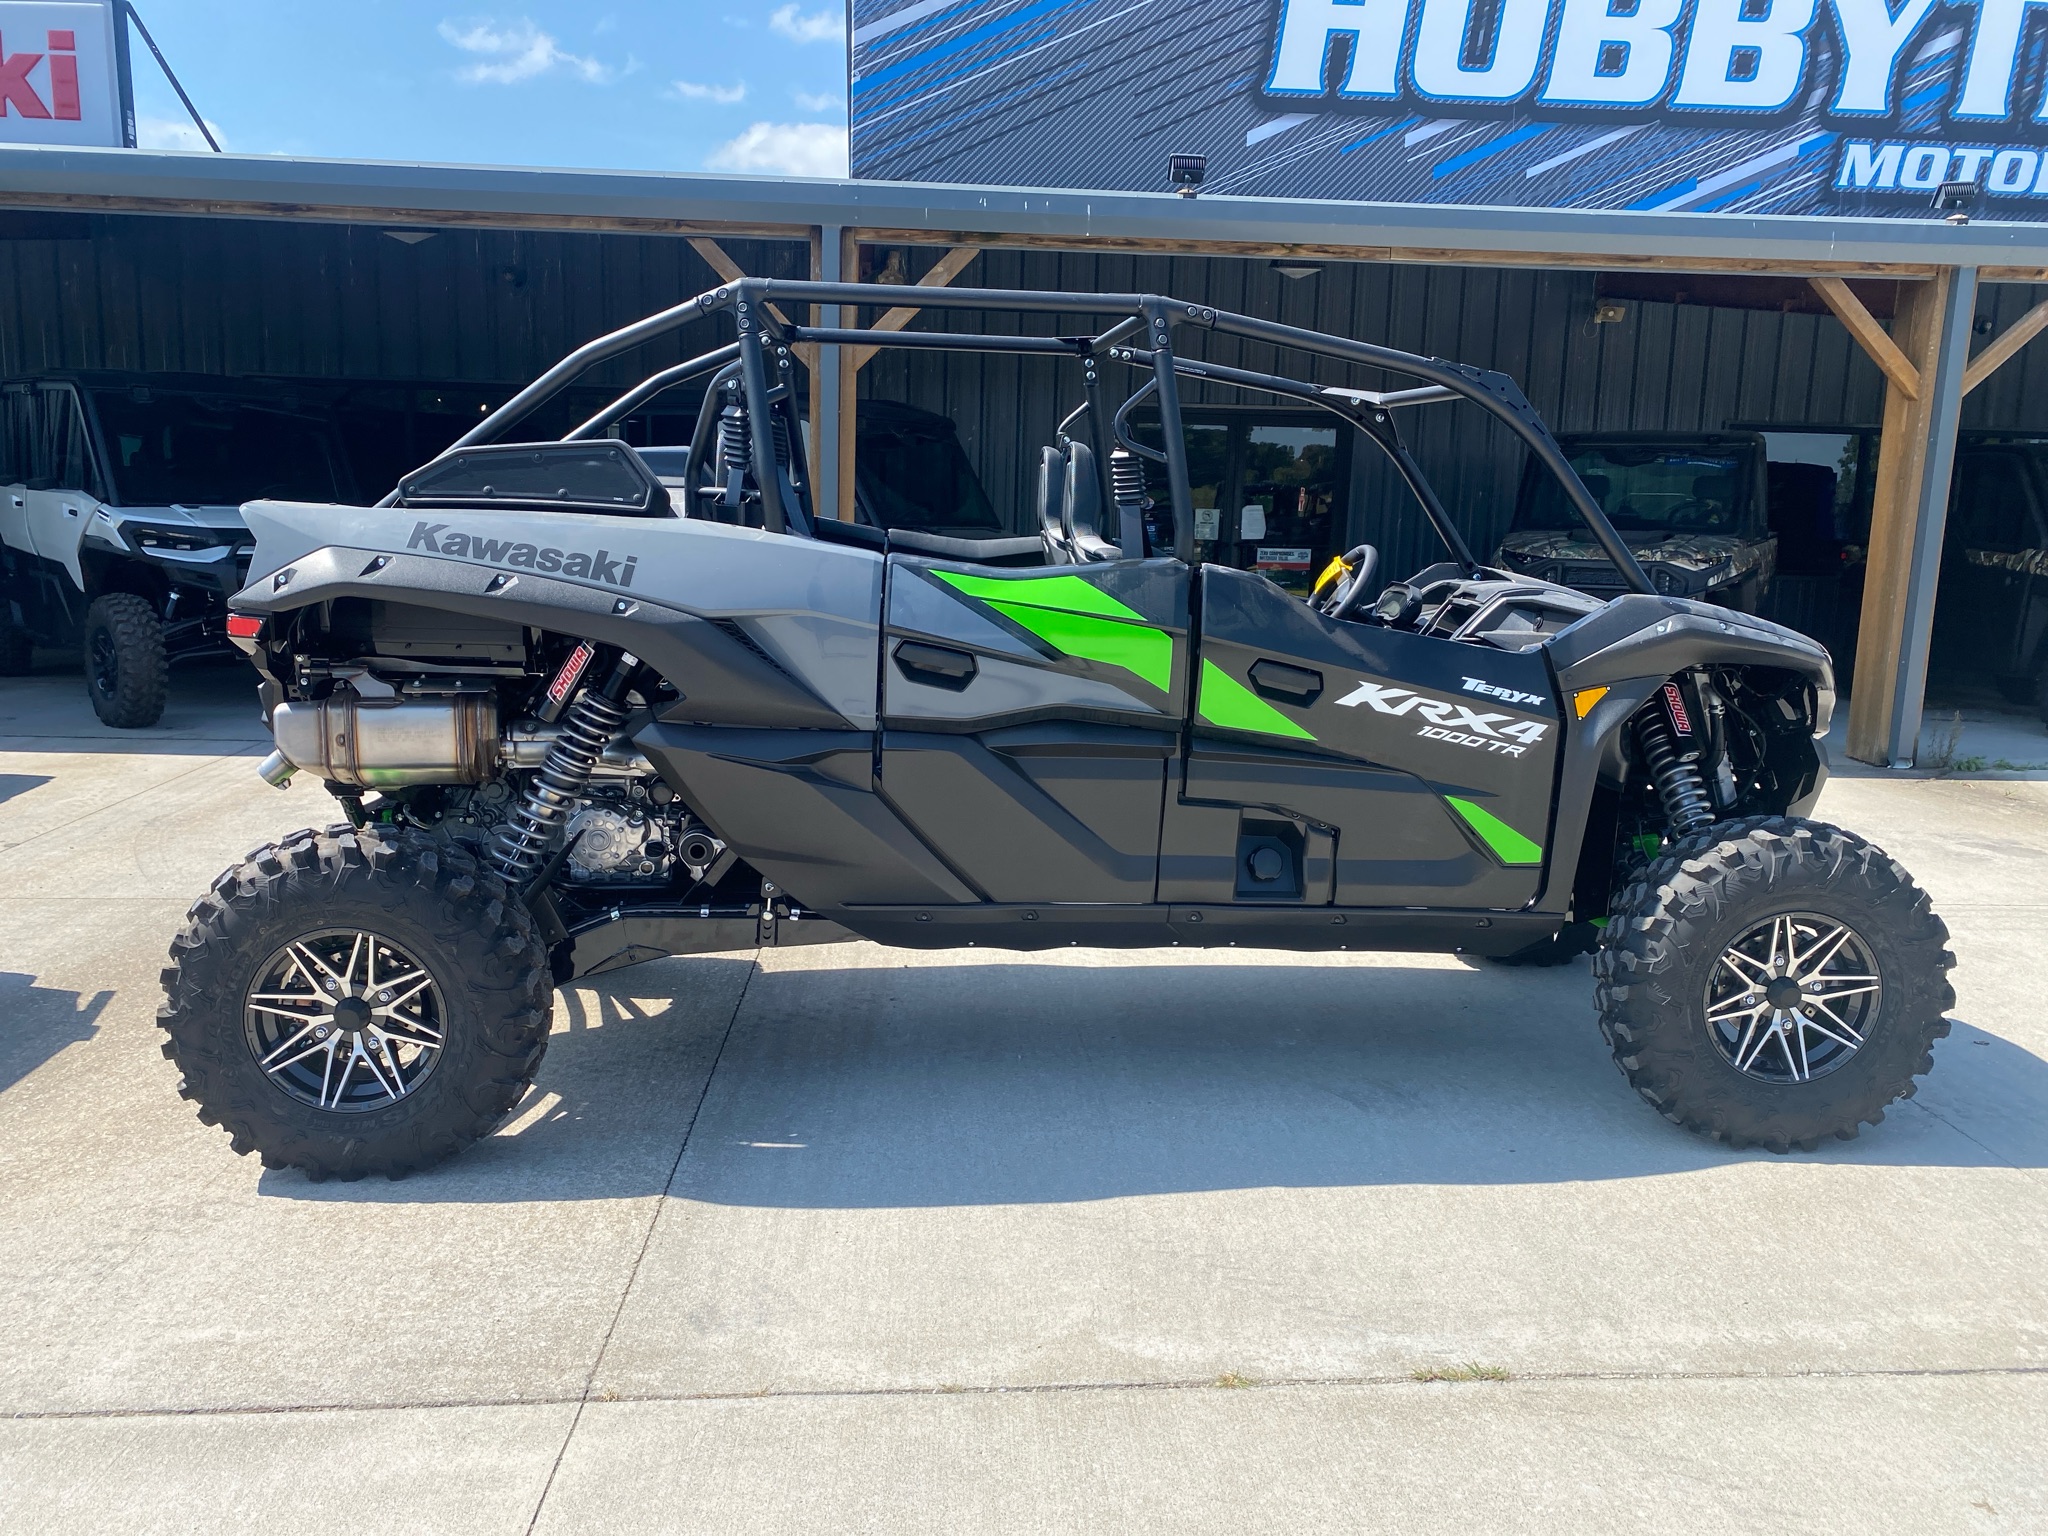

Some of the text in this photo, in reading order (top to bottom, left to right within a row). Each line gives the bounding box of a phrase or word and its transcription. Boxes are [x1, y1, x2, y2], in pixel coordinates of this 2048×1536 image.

[1268, 0, 2048, 118] HOBBYT
[406, 521, 638, 588] Kawasaki
[551, 645, 589, 702] SHOWA
[1333, 680, 1549, 745] KRX4
[1663, 686, 1692, 732] SHOWA
